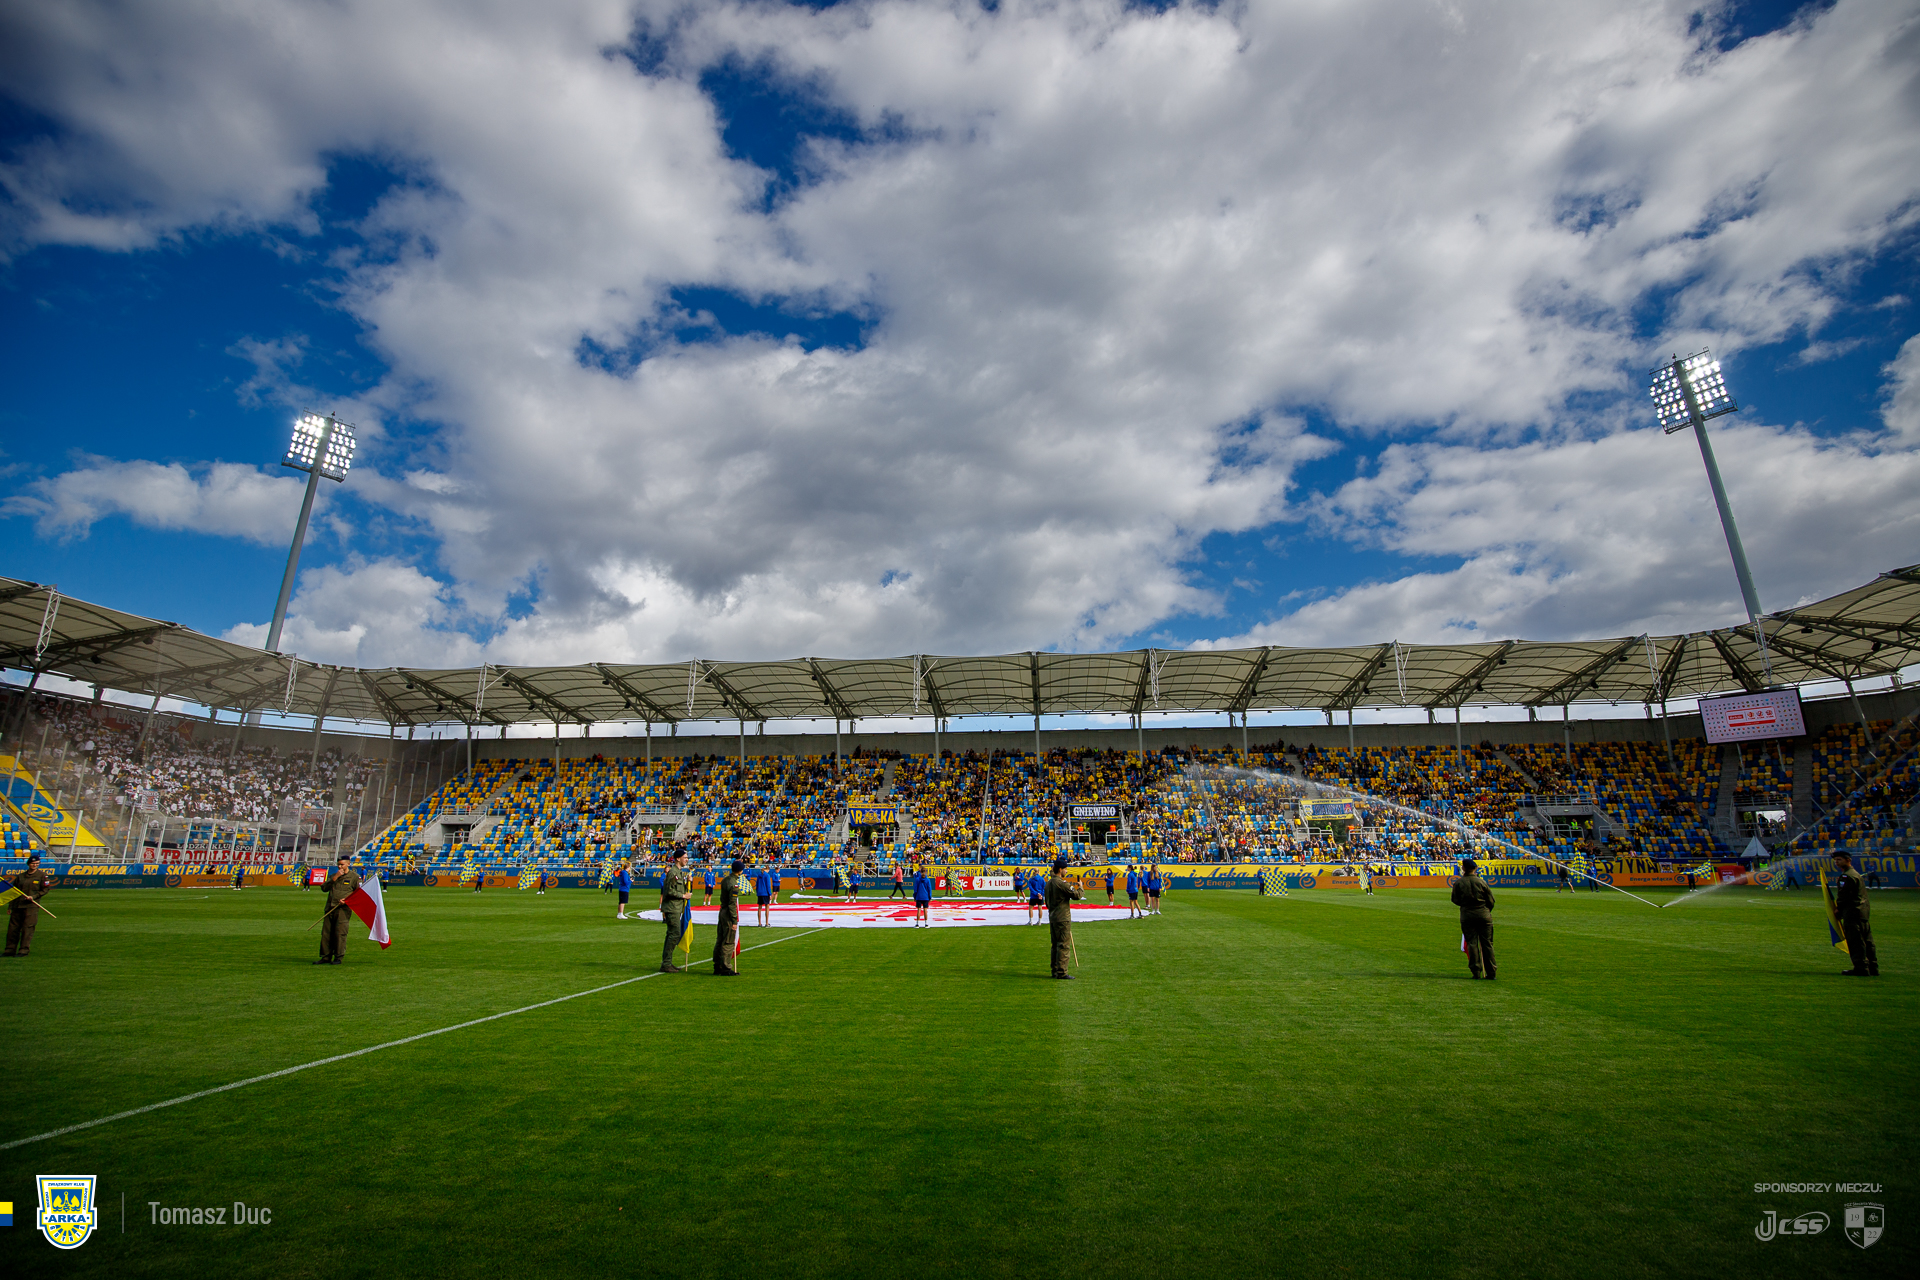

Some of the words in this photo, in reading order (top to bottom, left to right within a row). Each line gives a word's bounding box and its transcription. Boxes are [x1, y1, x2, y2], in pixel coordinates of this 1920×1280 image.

[1073, 806, 1117, 817] GNIEWINO
[177, 843, 208, 851] ŁDZKI
[161, 849, 285, 866] TROULEMAKES
[67, 865, 128, 876] GDYNIA
[166, 865, 276, 876] SKLEP.AKA.GYNIA.PL
[1395, 866, 1421, 876] POW
[1428, 866, 1454, 876] POW
[1481, 864, 1526, 875] ARTUZY
[63, 877, 98, 886] Energa
[1206, 880, 1236, 888] Energa
[1500, 877, 1530, 885] Energa
